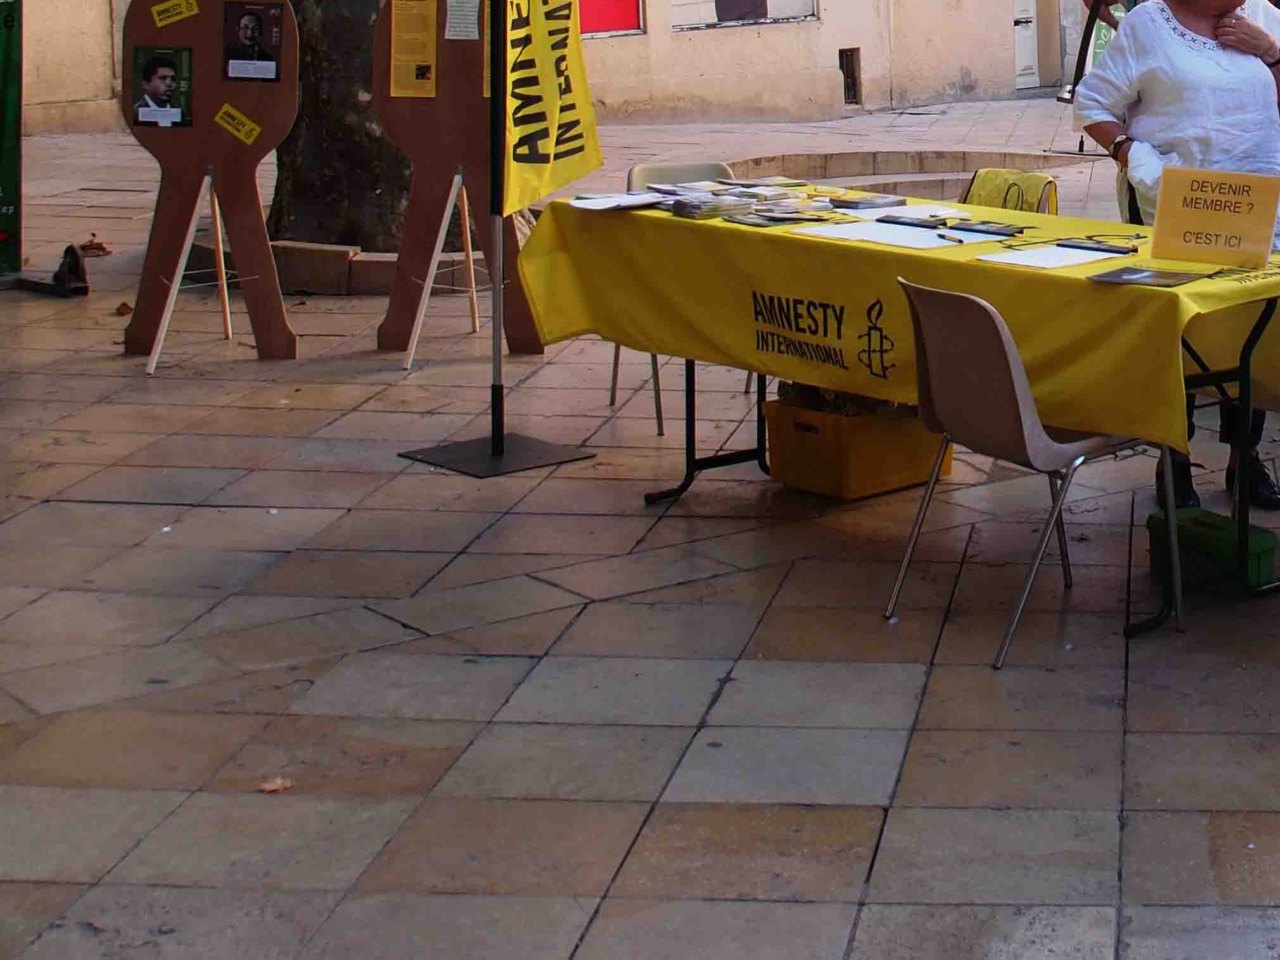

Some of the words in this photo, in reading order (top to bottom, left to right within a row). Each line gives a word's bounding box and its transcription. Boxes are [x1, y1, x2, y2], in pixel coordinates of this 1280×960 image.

[1190, 179, 1252, 197] DEVENIR
[1182, 196, 1242, 214] MEMBRE
[1182, 231, 1222, 247] C'EST
[1224, 234, 1242, 248] ICI
[752, 290, 845, 340] AMNESTY
[756, 329, 850, 370] INTERNATIONAL
